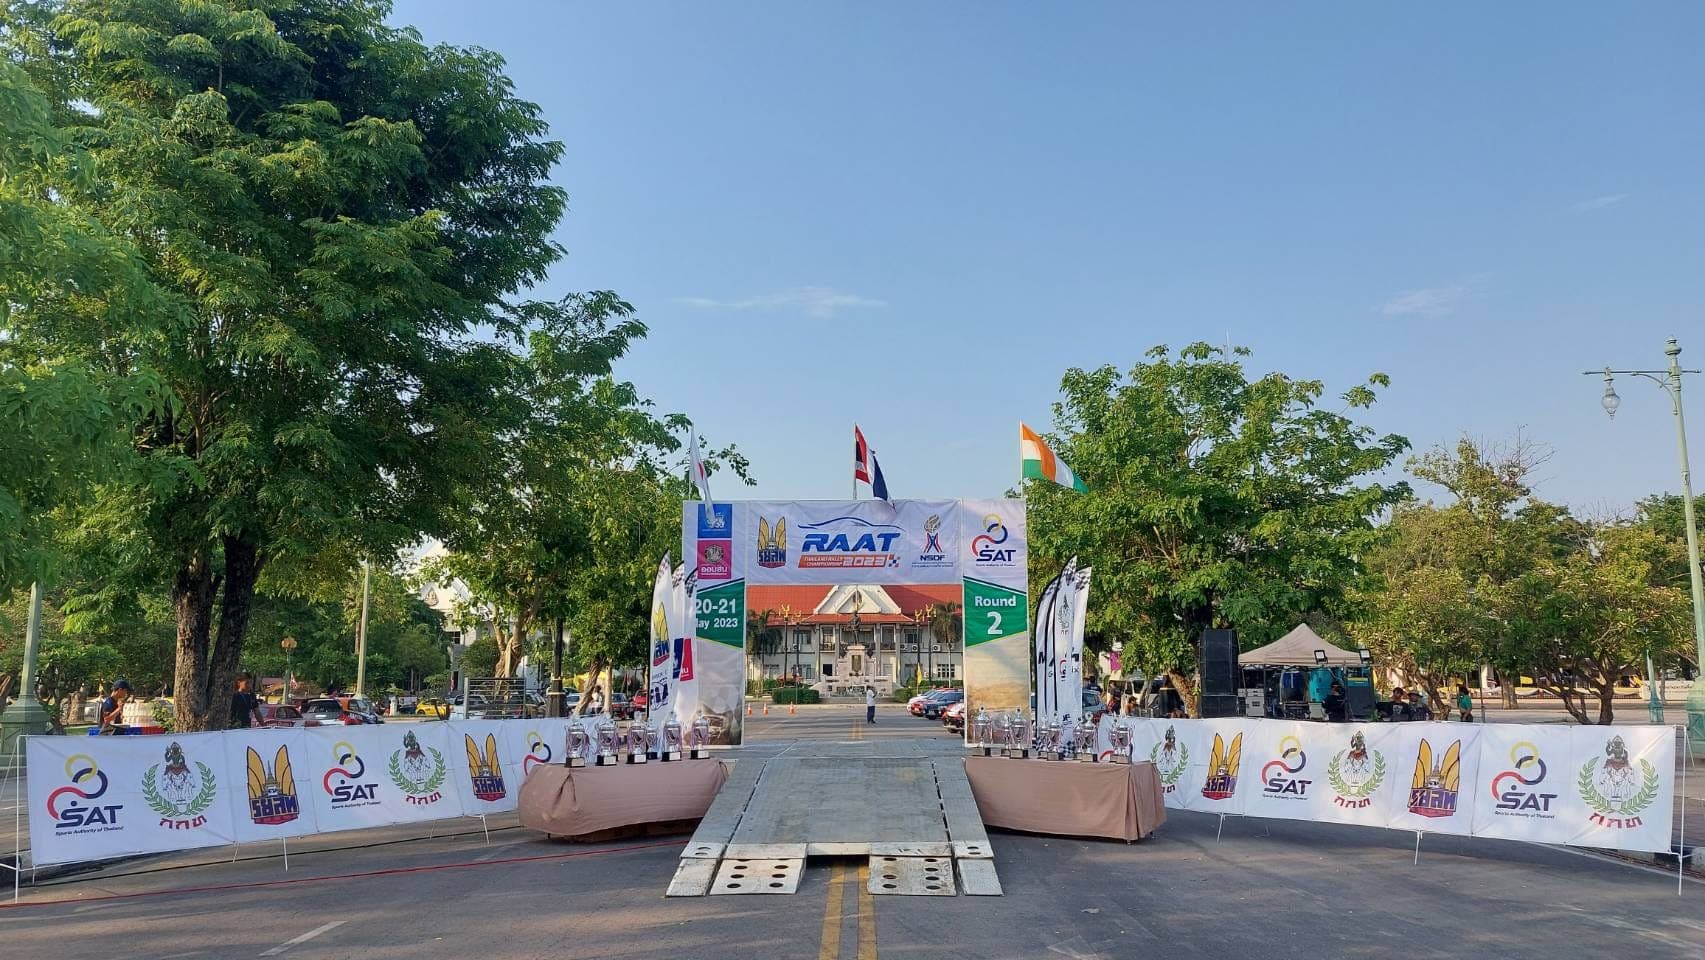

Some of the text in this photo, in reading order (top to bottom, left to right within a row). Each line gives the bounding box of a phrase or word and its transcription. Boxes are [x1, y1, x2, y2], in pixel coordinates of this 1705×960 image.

[802, 532, 900, 552] RAAT
[842, 556, 886, 567] 2023
[976, 549, 1016, 561] SAT
[974, 595, 1017, 606] Round
[696, 617, 738, 630] ay 2023
[986, 611, 1003, 635] 2
[331, 783, 379, 803] SAT
[1263, 777, 1313, 795] SAT
[405, 791, 442, 805] กกท
[1334, 796, 1371, 808] กกท
[1496, 791, 1558, 811] SAT
[56, 805, 124, 829] SAT
[159, 815, 208, 830] กกท
[1588, 812, 1643, 829] กกท
